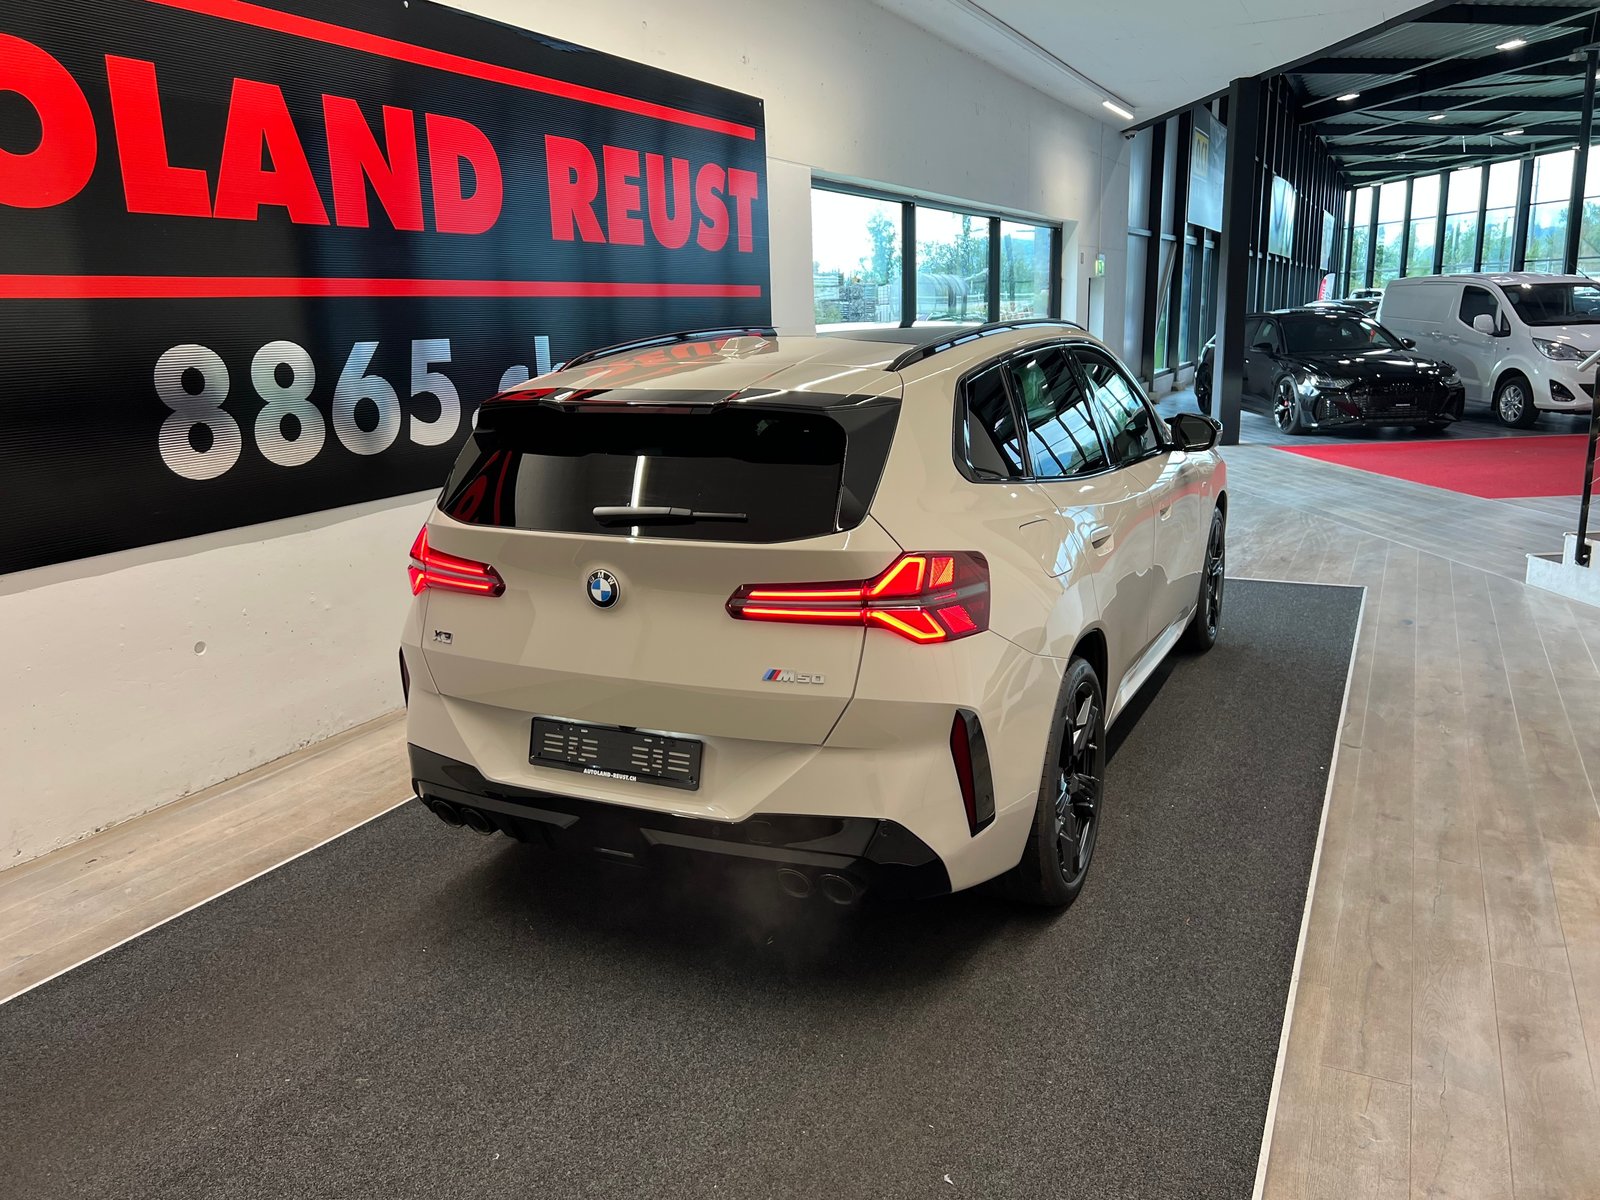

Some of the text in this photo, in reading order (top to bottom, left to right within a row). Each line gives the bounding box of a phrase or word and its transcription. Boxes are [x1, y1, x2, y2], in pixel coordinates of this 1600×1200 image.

[544, 134, 758, 253] REUST
[433, 629, 454, 644] X3
[774, 669, 825, 684] M50
[583, 768, 637, 781] AUTOLAND-REUST.CH
